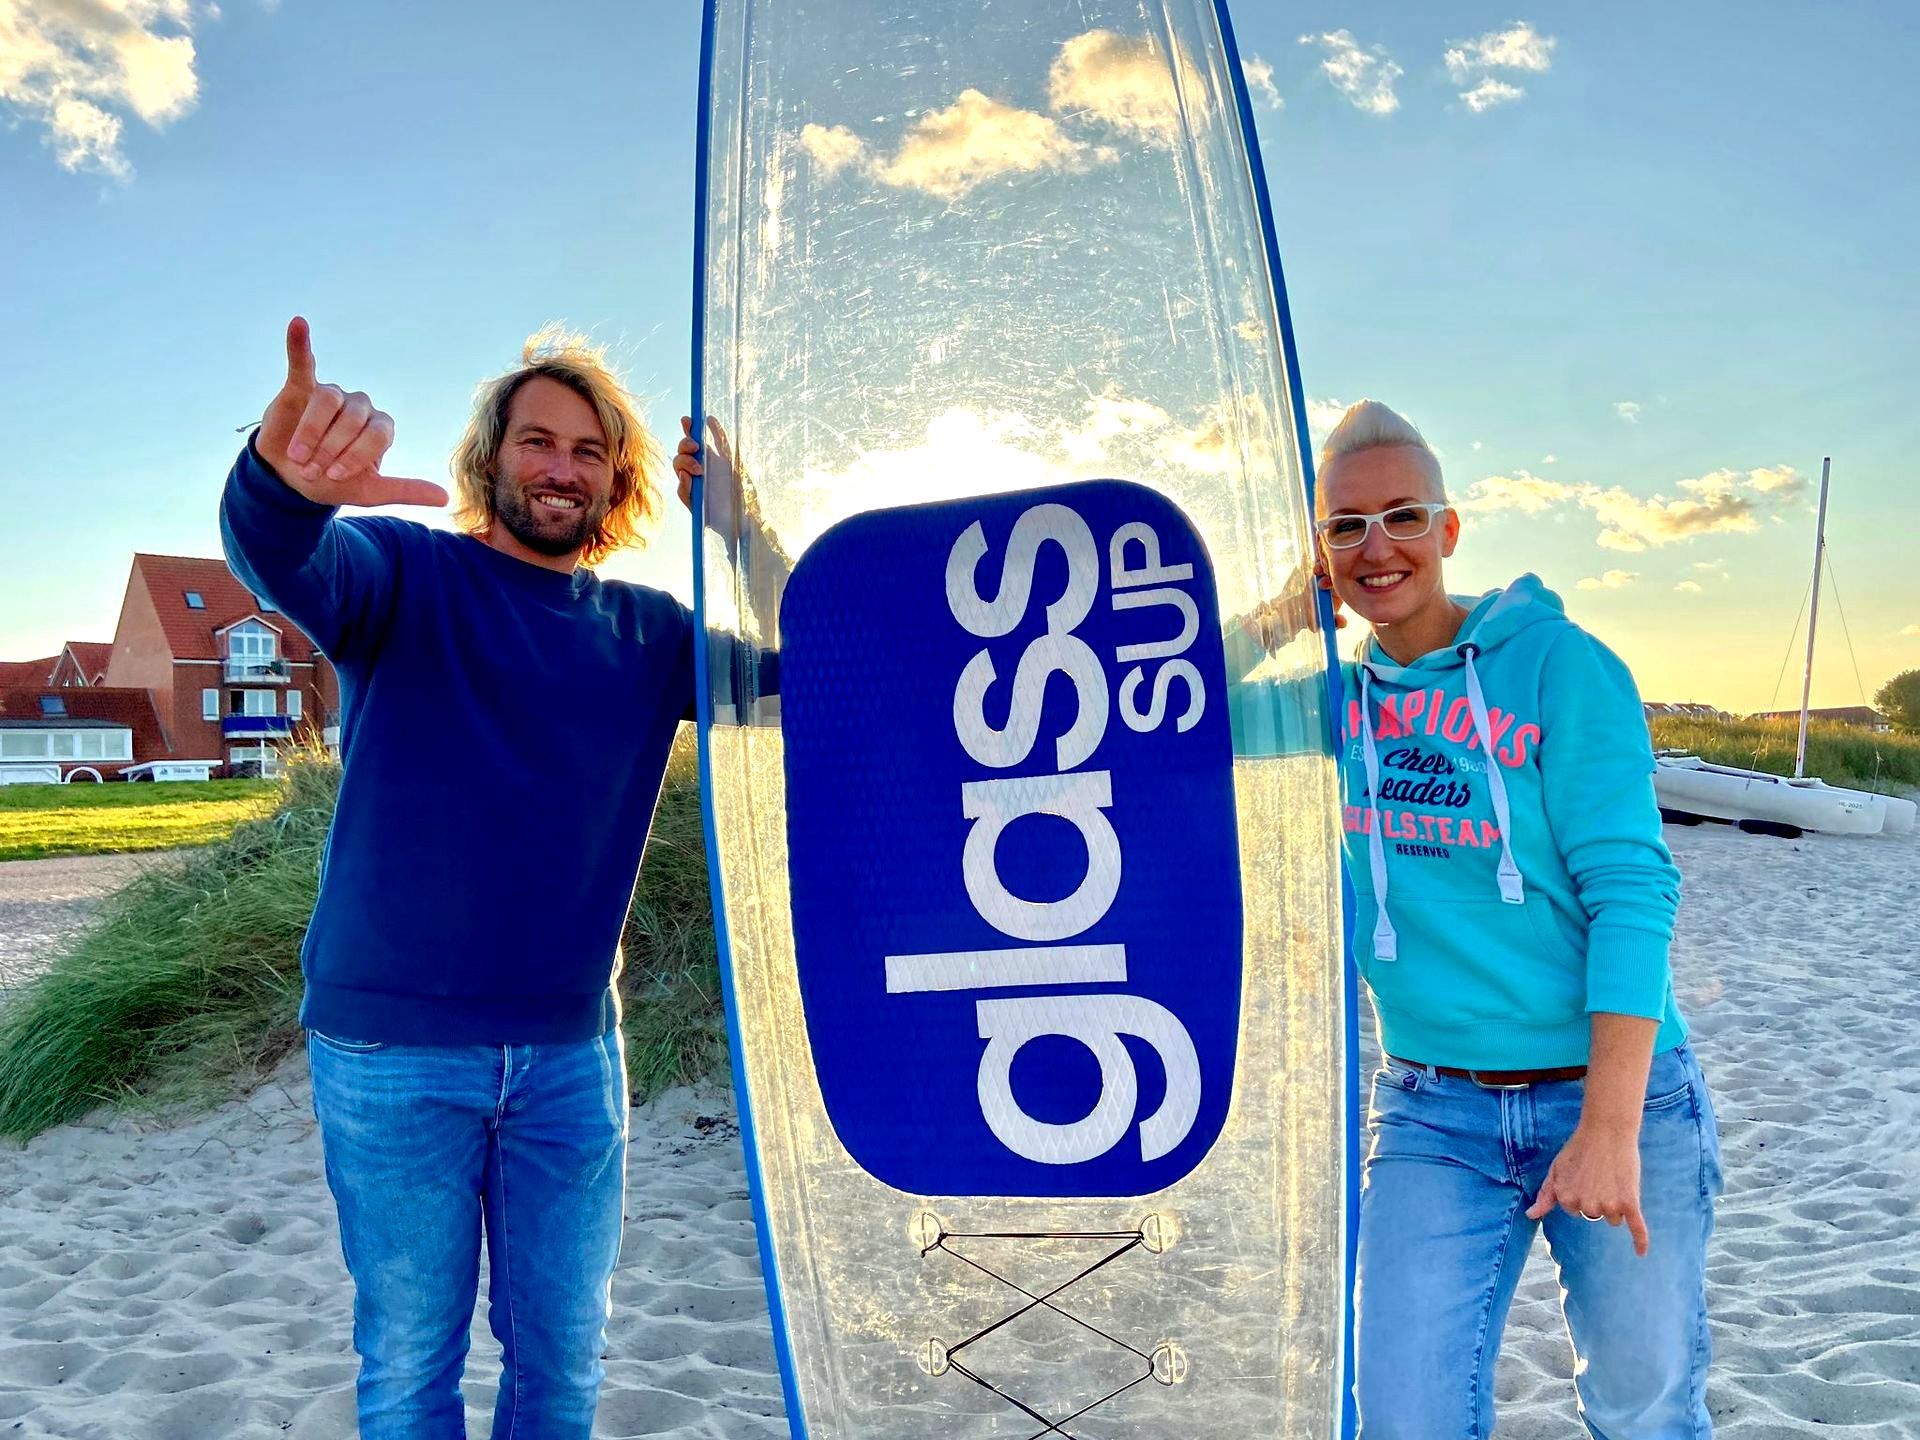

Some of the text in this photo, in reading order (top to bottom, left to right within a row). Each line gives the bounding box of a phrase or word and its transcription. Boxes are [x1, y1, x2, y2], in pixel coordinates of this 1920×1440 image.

[1108, 521, 1206, 733] SUP
[885, 503, 1202, 1165] glass
[1363, 777, 1471, 808] eaders
[1396, 843, 1450, 859] RESERVED
